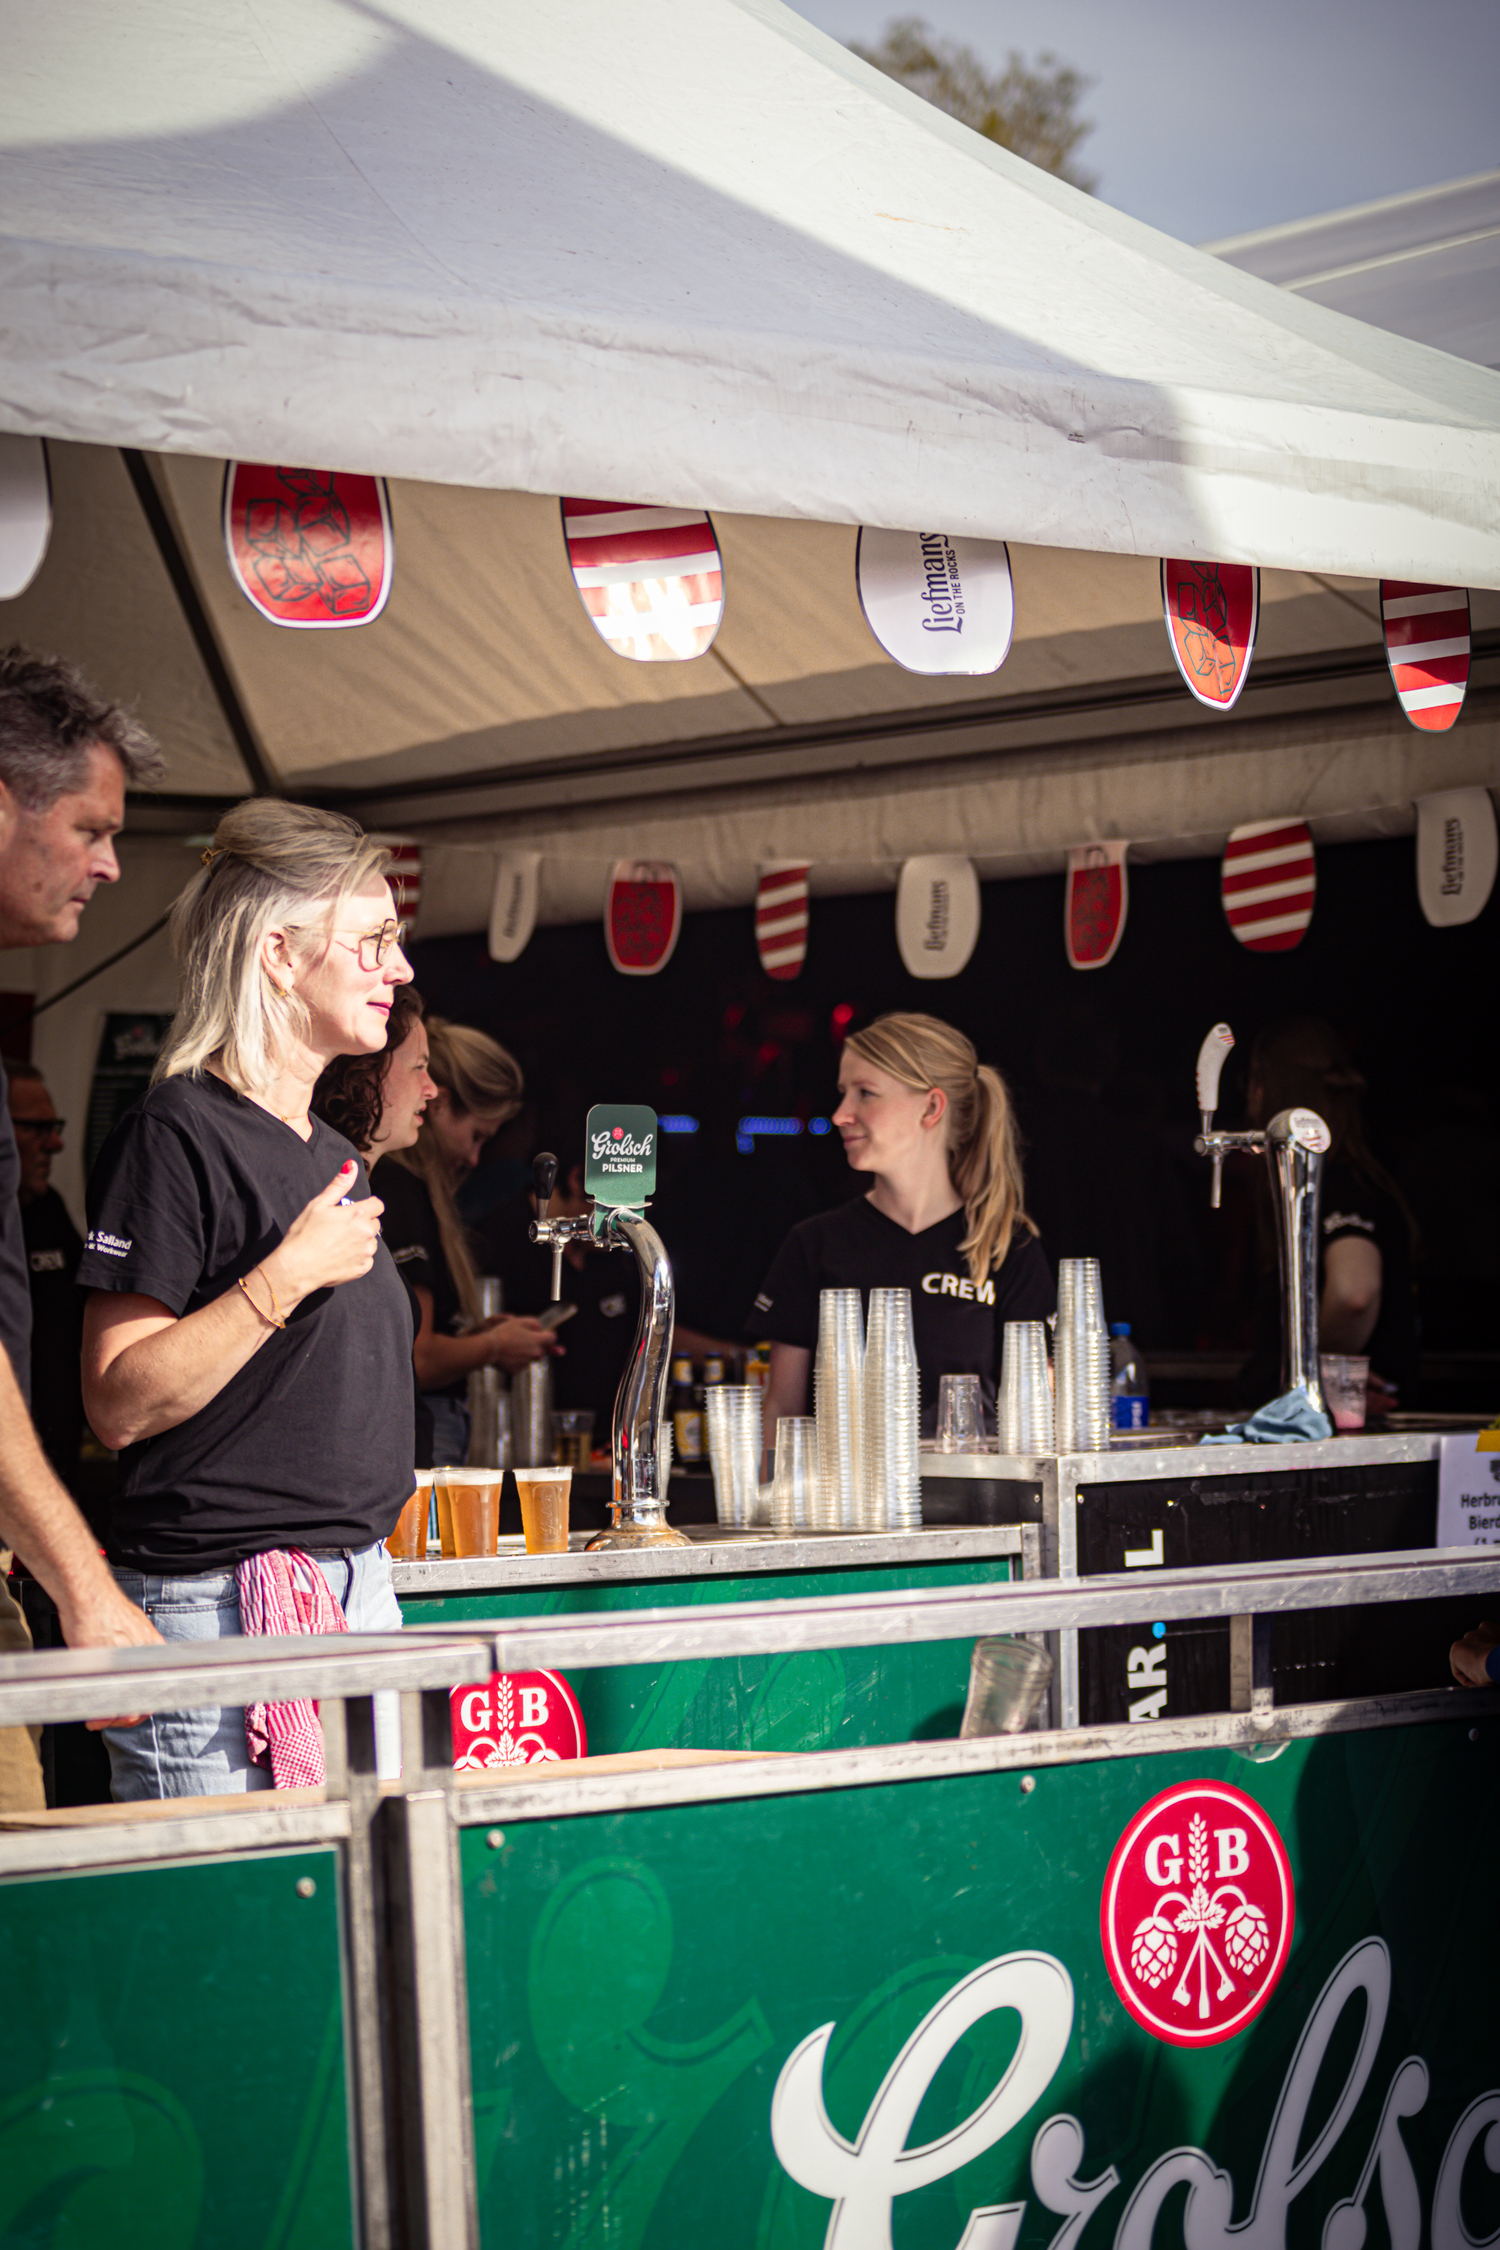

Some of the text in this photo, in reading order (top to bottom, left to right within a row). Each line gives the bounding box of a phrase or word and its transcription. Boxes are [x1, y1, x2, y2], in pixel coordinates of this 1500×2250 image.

[920, 533, 963, 634] Liefmans
[946, 550, 965, 615] ON THE ROCKS
[591, 1131, 654, 1160] Grolsch
[602, 1163, 643, 1173] PILSNER
[96, 1230, 132, 1250] Salland
[96, 1243, 128, 1258] Workwear
[922, 1272, 996, 1306] CREW
[460, 1687, 549, 1732] G B
[1144, 1827, 1250, 1886] G B
[770, 1935, 1500, 2250] Grolsc
